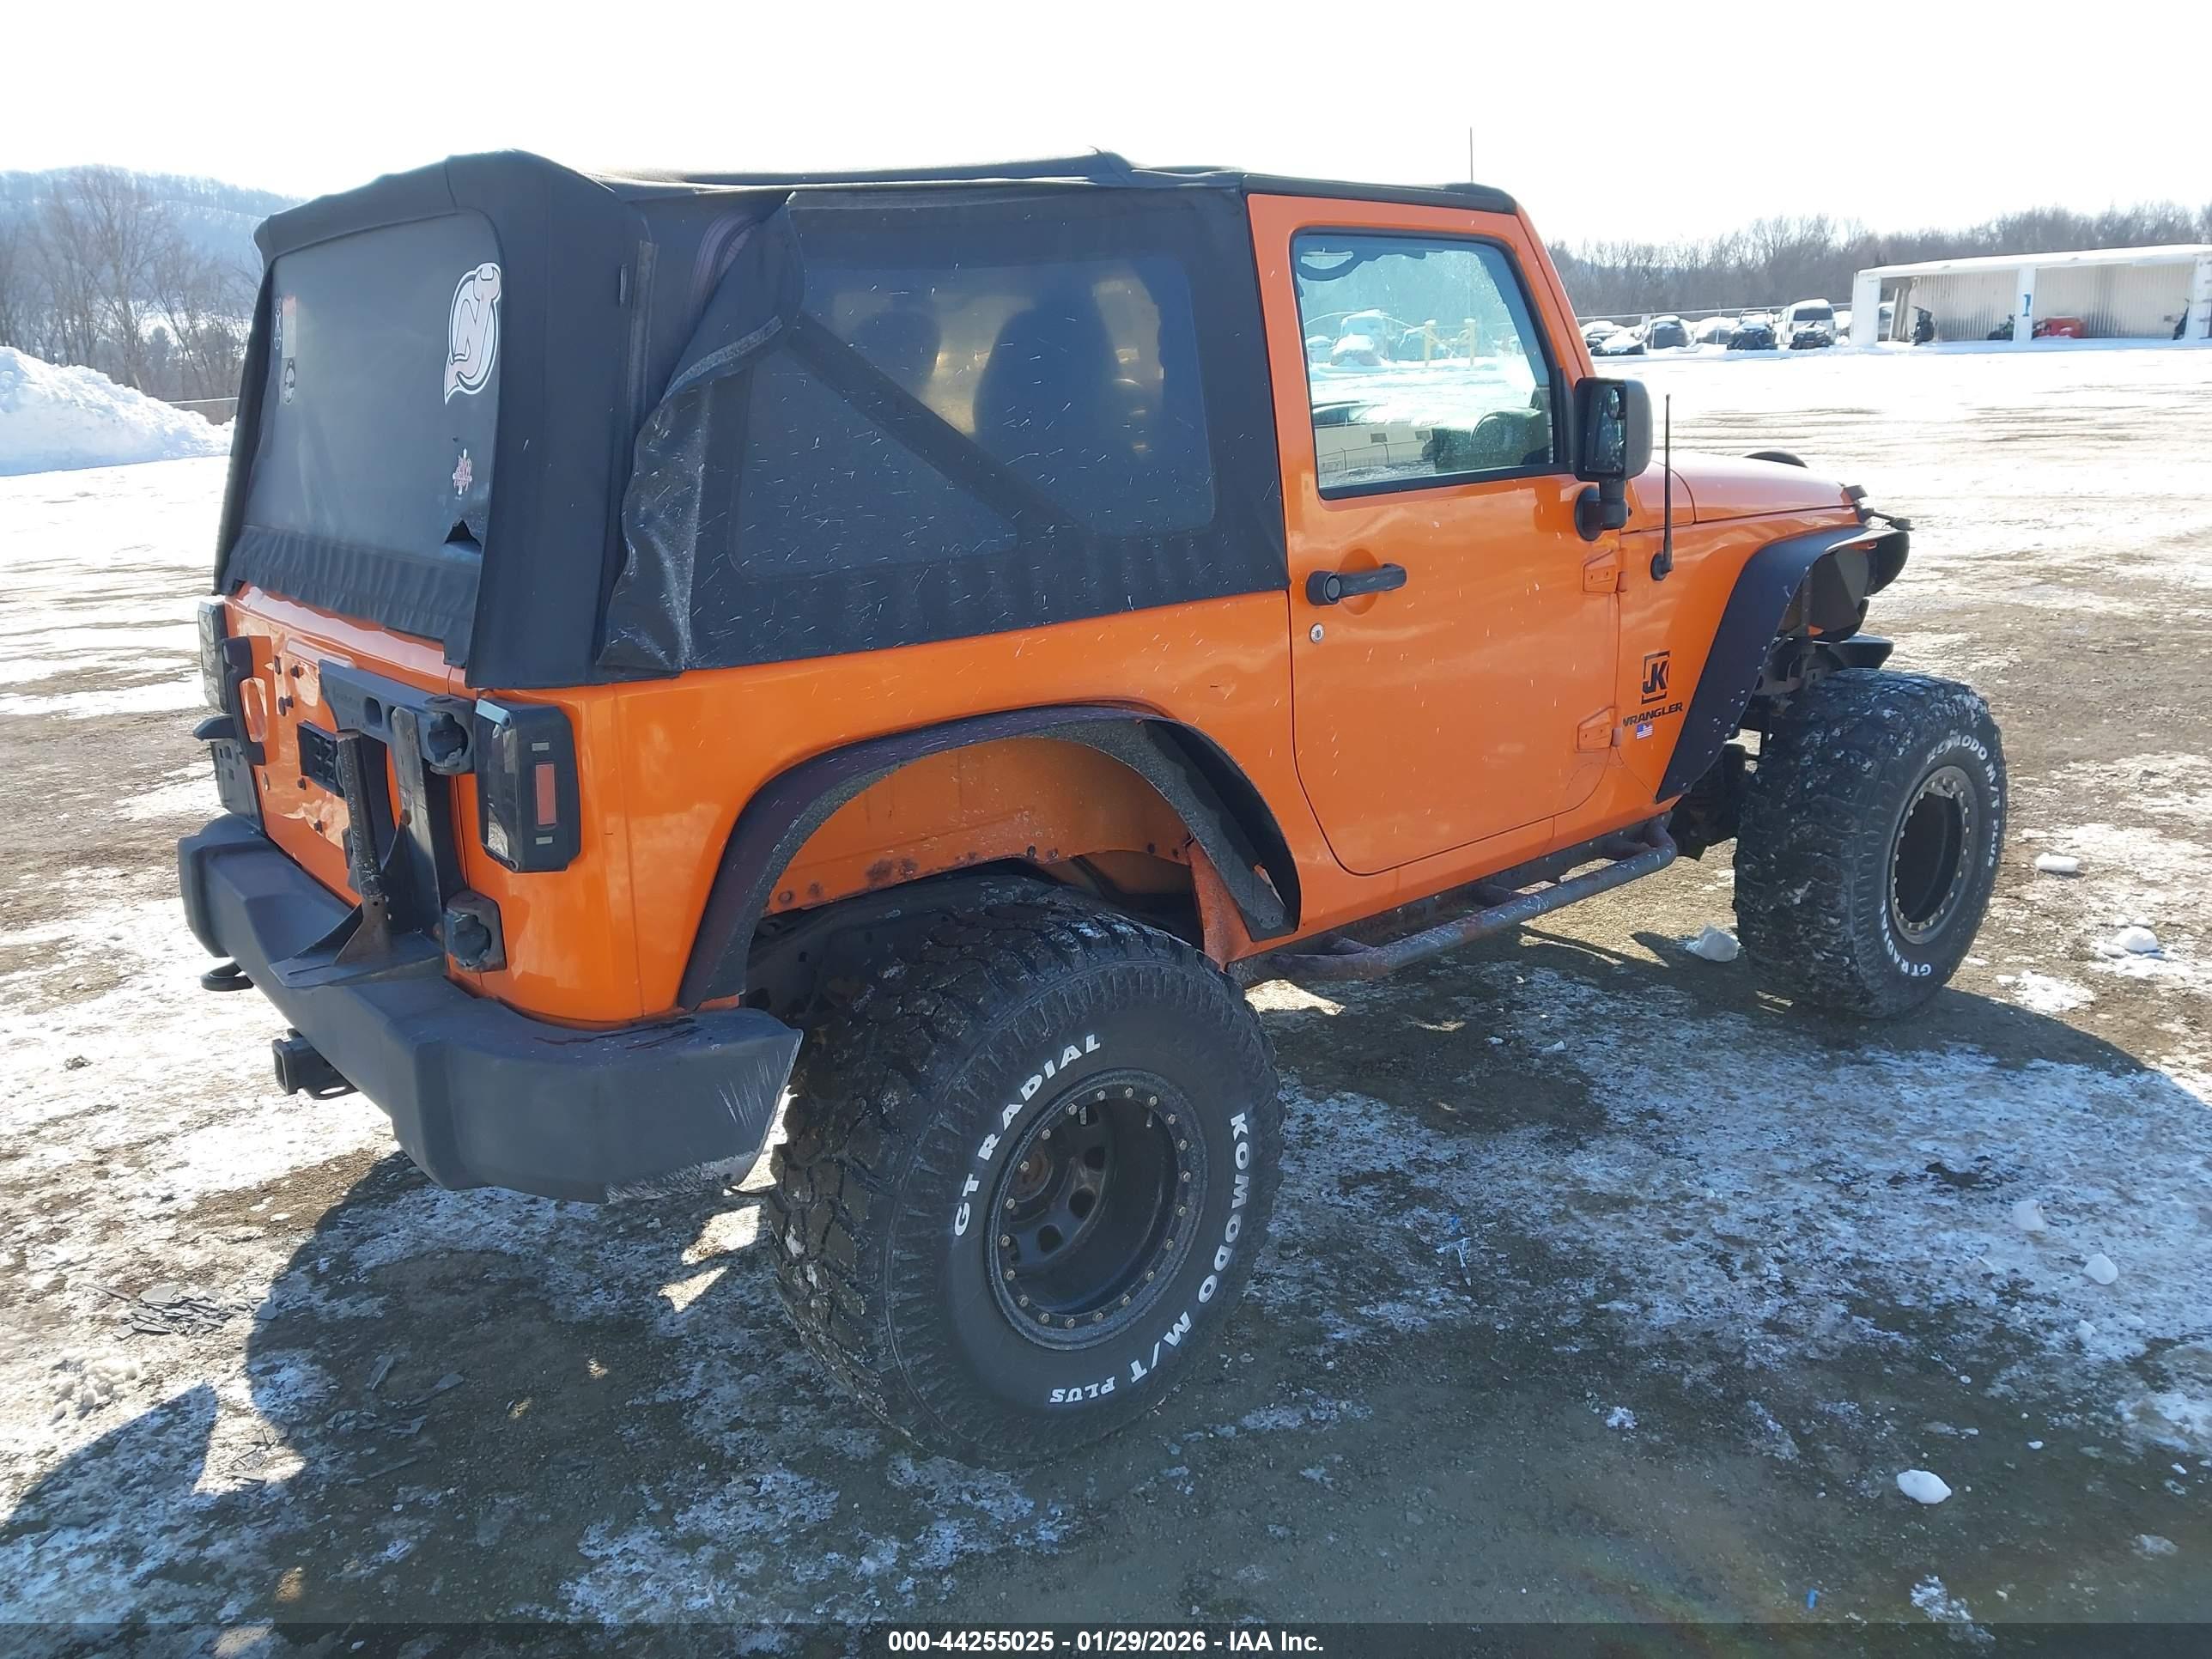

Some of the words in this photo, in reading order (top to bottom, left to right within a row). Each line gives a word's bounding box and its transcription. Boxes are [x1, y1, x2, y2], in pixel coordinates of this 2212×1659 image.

[2022, 294, 2032, 317] 1
[1642, 659, 1668, 694] JK
[1622, 702, 1683, 726] WRANGLER
[1926, 734, 1988, 765] KOMODO
[1880, 899, 1909, 973] RADIAL
[1911, 963, 1931, 976] GT
[954, 1173, 980, 1237] GT
[977, 1033, 1102, 1162] RADIAL
[1198, 1112, 1250, 1304] KOMODO
[1129, 1310, 1192, 1384] M/T
[1048, 1376, 1115, 1404] PLUS
